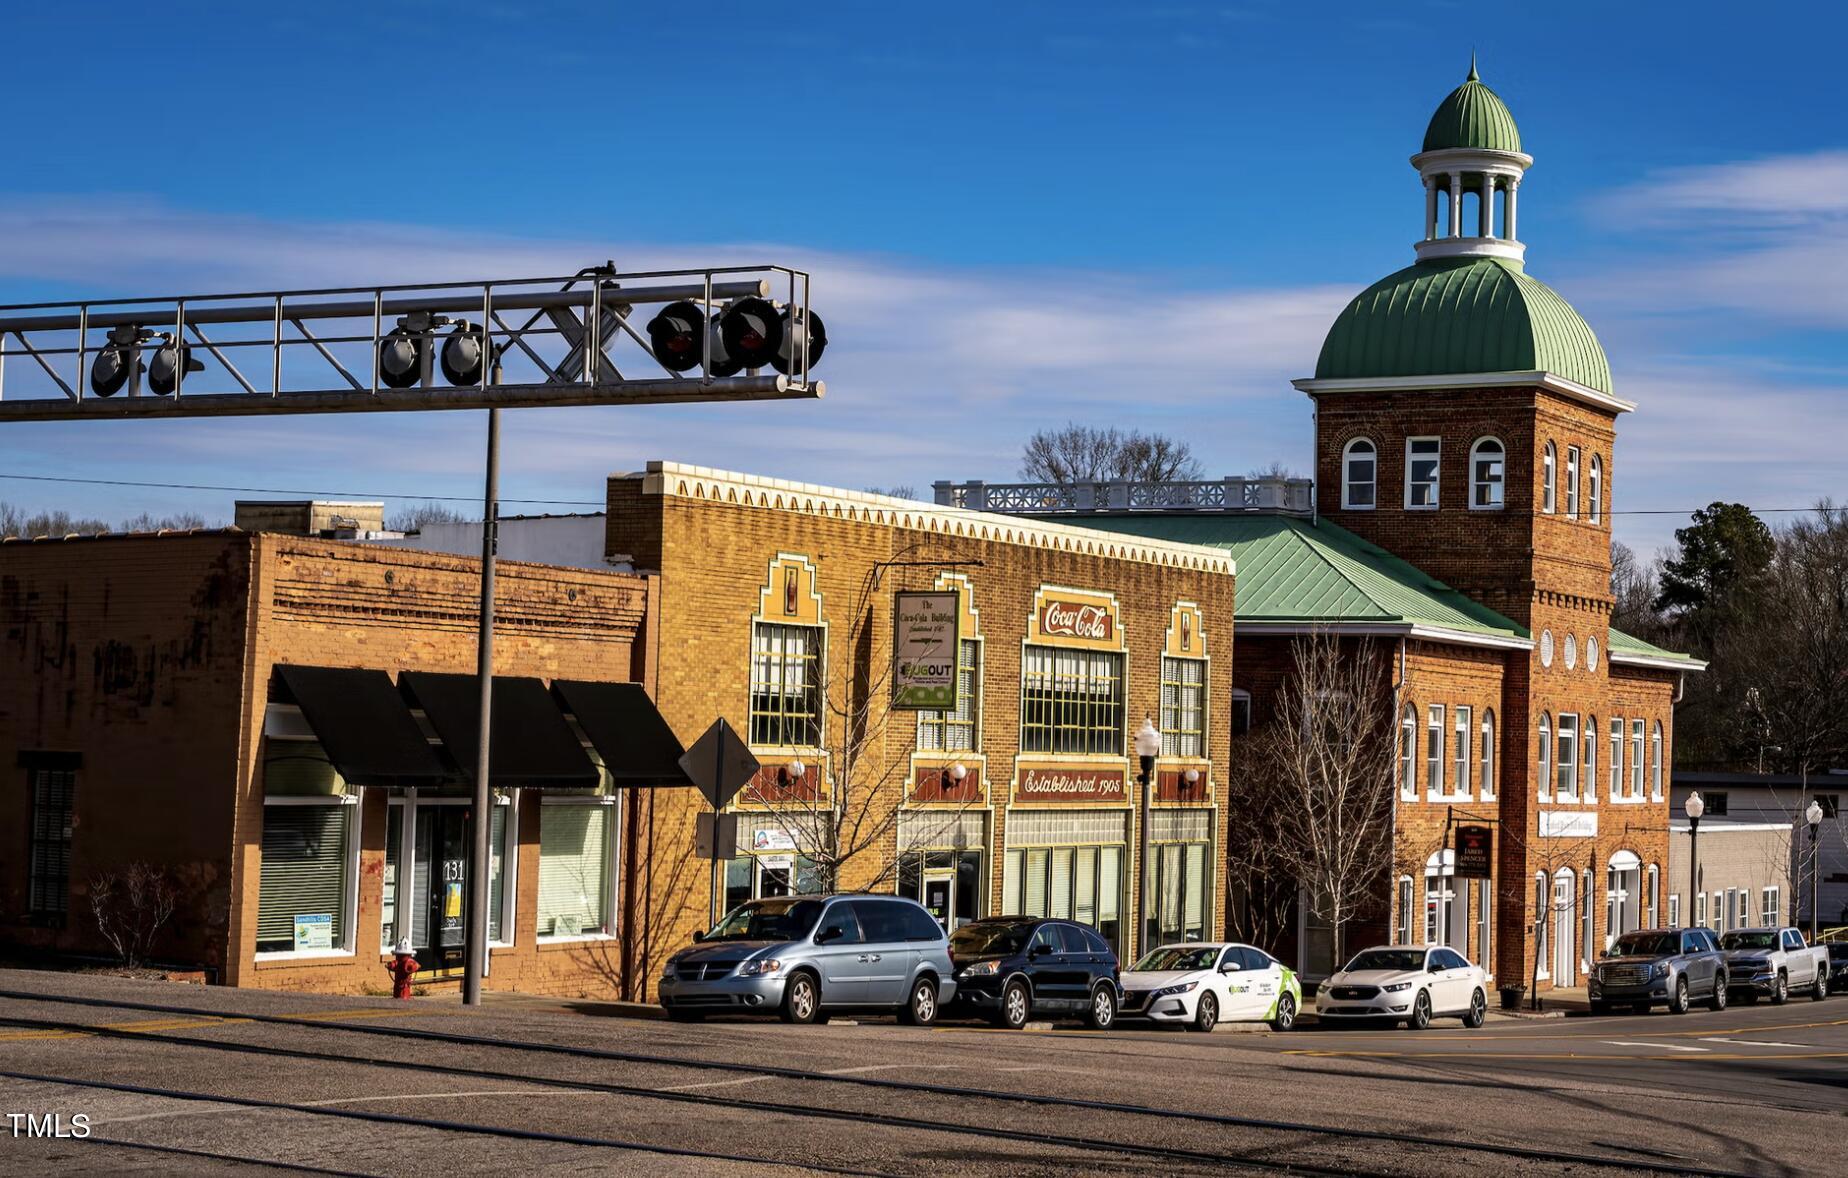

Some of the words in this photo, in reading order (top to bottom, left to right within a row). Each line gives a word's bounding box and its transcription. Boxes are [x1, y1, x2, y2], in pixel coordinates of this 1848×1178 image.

[922, 600, 933, 609] The
[1045, 602, 1106, 638] Coca-Cola
[1025, 770, 1096, 793] Established
[1098, 780, 1120, 796] 1905
[444, 861, 464, 881] 131
